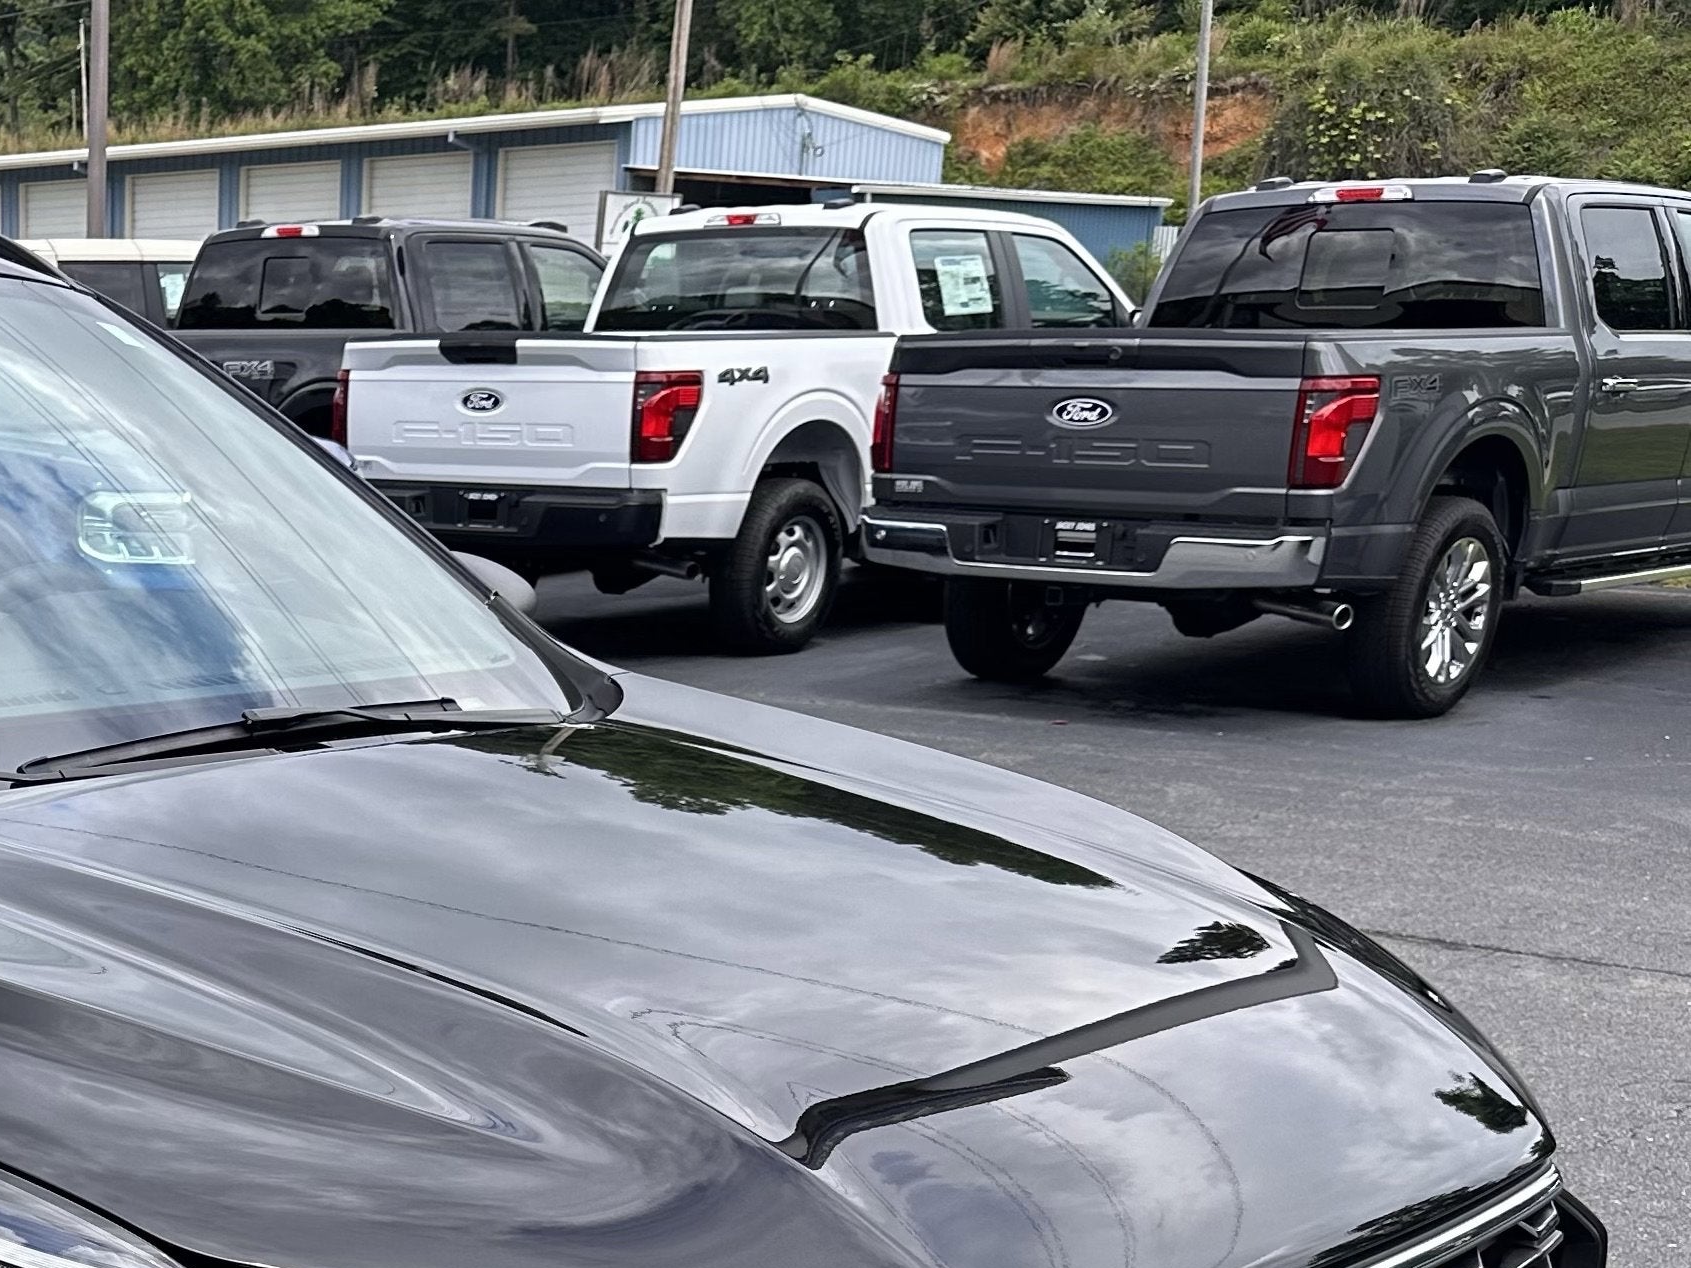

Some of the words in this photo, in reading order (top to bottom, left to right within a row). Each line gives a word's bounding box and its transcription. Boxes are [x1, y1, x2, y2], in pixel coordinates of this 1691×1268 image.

[1391, 373, 1443, 399] FX4
[465, 391, 497, 410] Ford
[1061, 401, 1102, 421] Ford
[391, 420, 574, 447] F-150
[954, 434, 1211, 469] F-150
